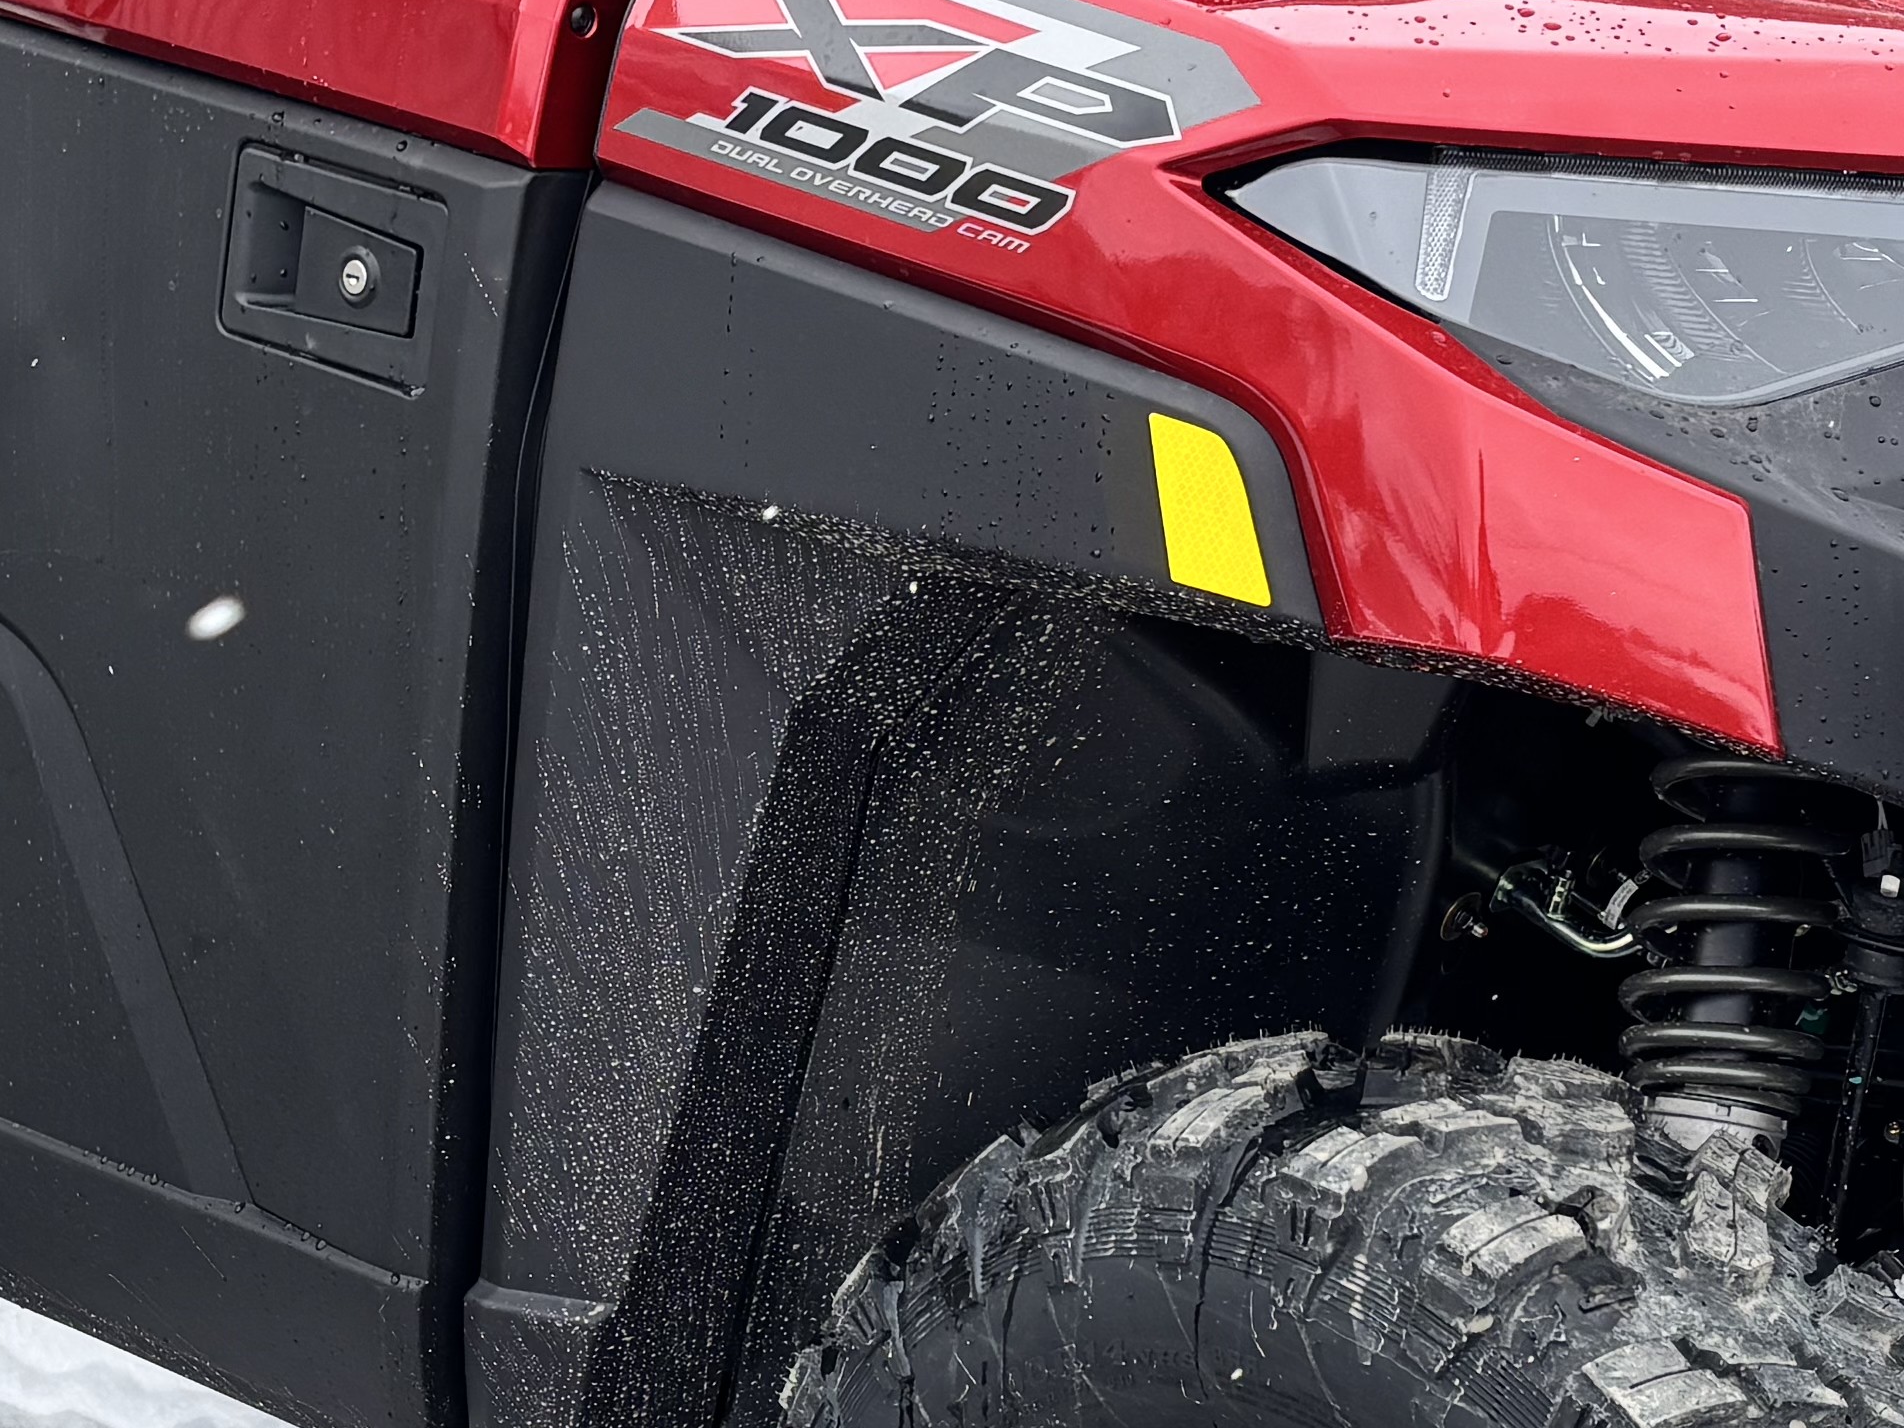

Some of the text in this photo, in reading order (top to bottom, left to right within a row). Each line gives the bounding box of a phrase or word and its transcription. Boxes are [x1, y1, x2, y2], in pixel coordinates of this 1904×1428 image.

[710, 139, 1031, 254] DUAL OVERHEAD CAM
[724, 89, 1077, 235] 1000
